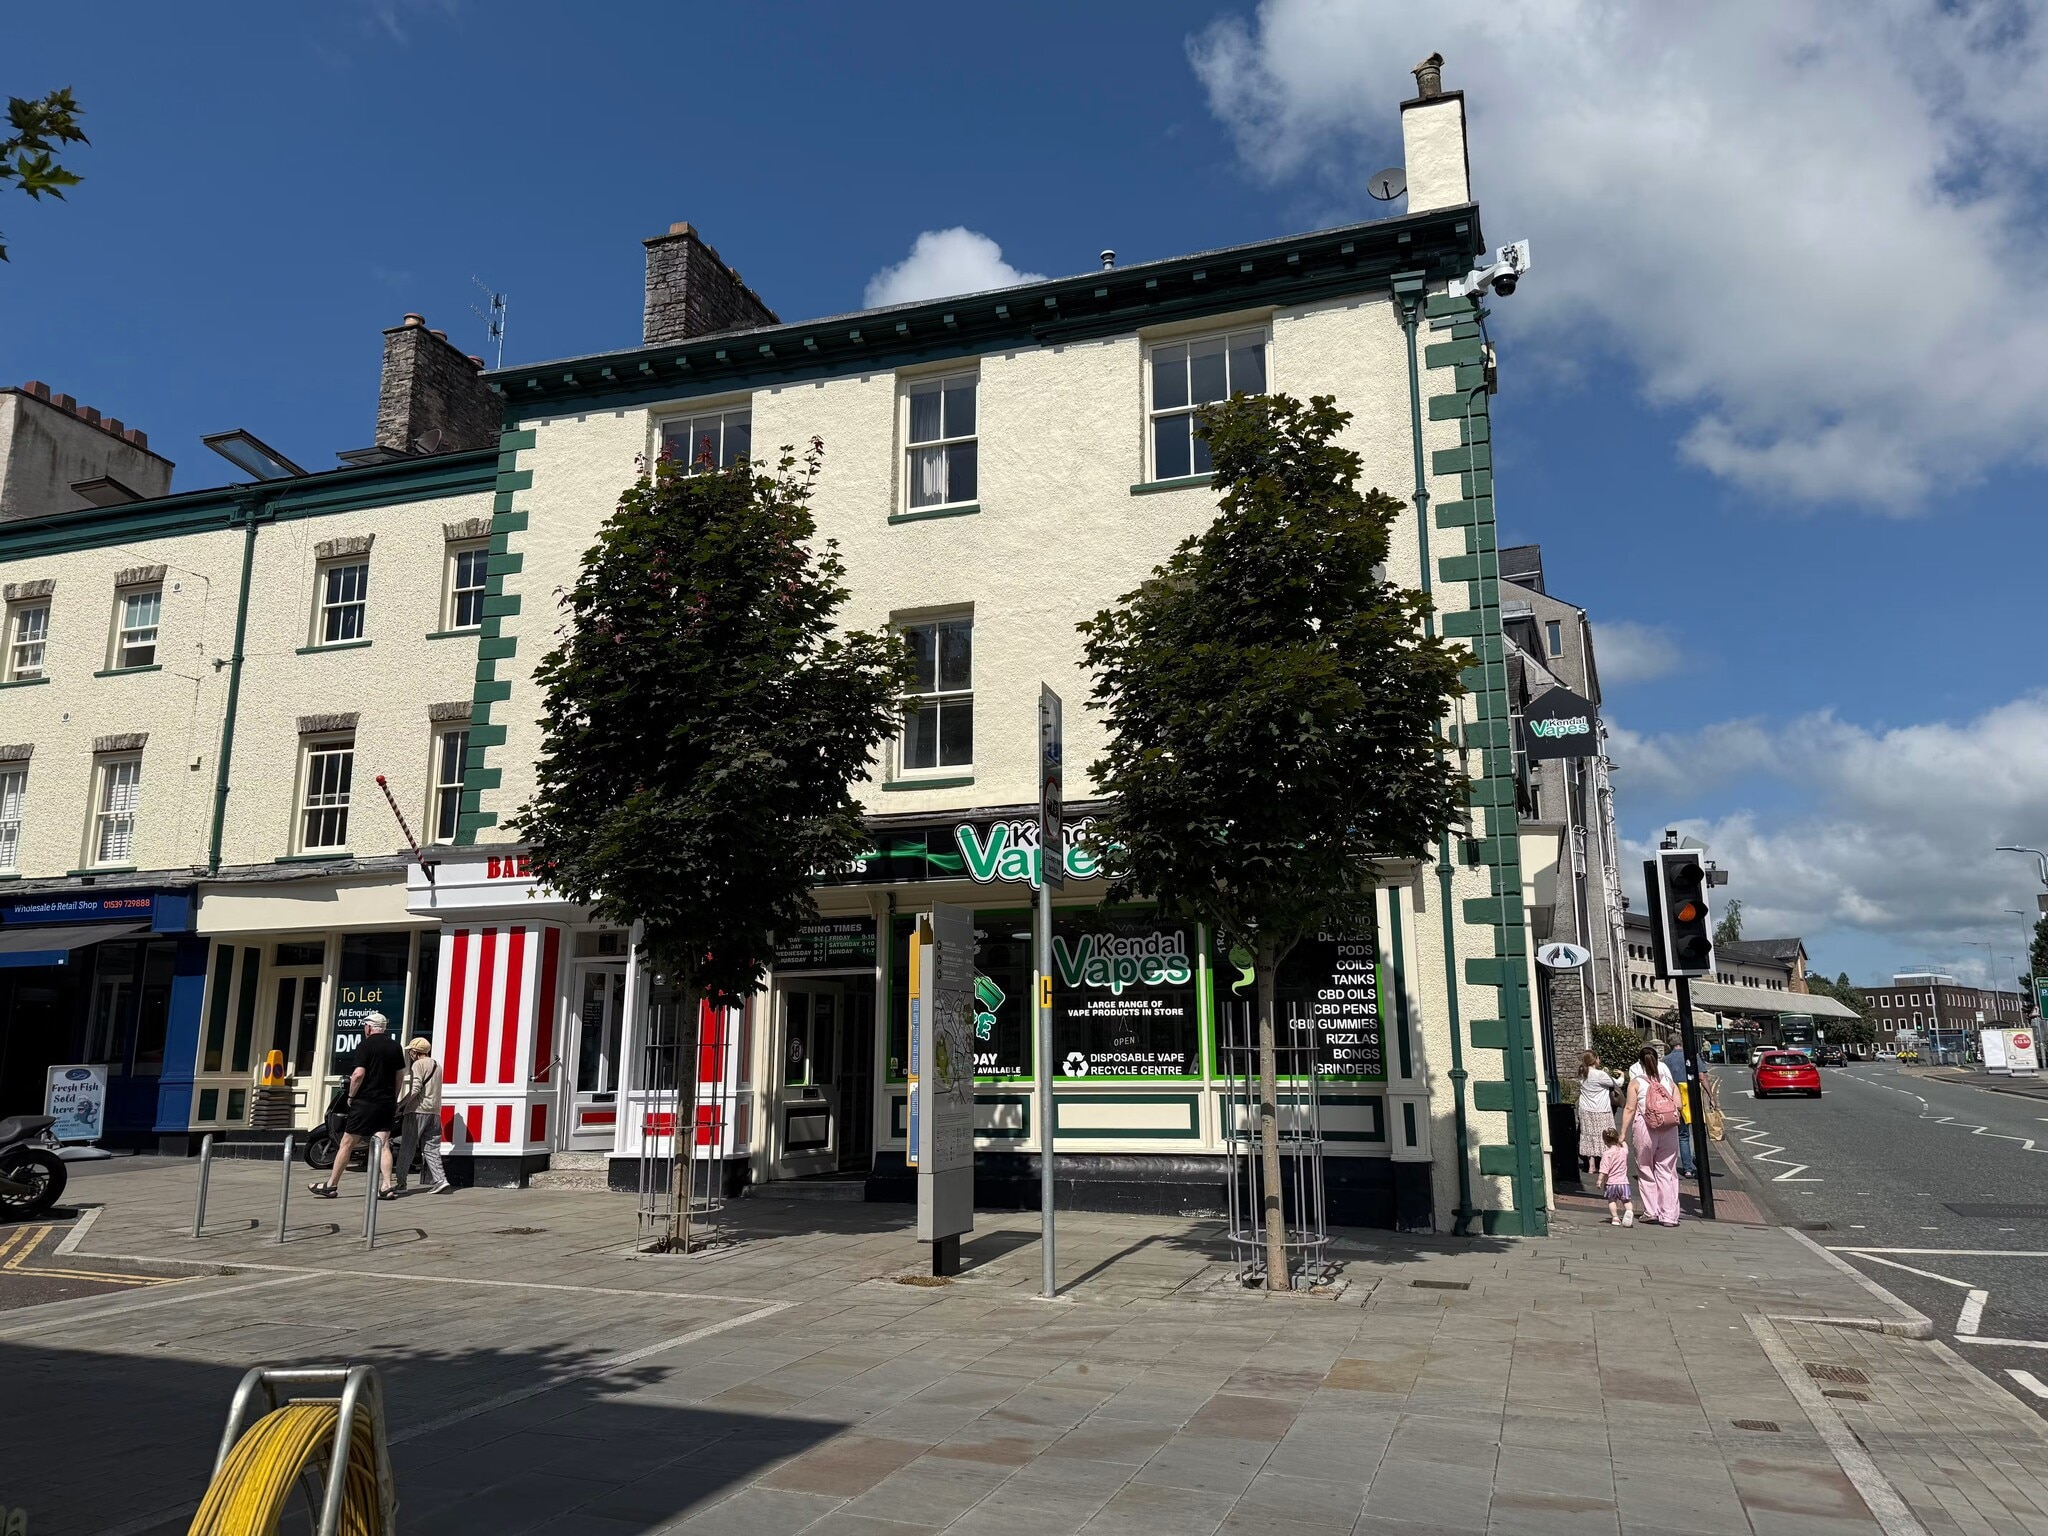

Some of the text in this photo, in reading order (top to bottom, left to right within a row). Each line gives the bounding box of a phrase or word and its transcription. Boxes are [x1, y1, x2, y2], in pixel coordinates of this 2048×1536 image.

[1549, 717, 1586, 726] Kendal
[1531, 721, 1588, 737] Vapes
[1011, 819, 1100, 848] Knd
[957, 825, 1128, 887] Vae
[14, 899, 150, 913] Wholesale & Retail Shop 01539 729888
[799, 924, 862, 934] ENING TIMES
[1096, 932, 1183, 957] Kendal
[1338, 945, 1373, 956] PODS
[1052, 936, 1190, 994] Vapes
[1336, 960, 1374, 970] COILS
[1332, 974, 1375, 985] TANKS
[341, 987, 382, 1003] To Let
[1317, 988, 1376, 1000] CBD OILS
[1087, 1000, 1163, 1009] LARGE RANGE OF
[1314, 1004, 1377, 1014] CBD PENS
[339, 1008, 348, 1017] All
[1067, 1008, 1184, 1017] VAPE PRODUCTS IN STORE
[337, 1019, 357, 1027] 01539
[1289, 1018, 1378, 1030] CBD GUMMIES
[1113, 1036, 1135, 1047] OPEN
[1326, 1034, 1379, 1044] RIZZLAS
[1090, 1053, 1185, 1063] DISPOSABLE VAPE
[1333, 1048, 1380, 1059] BONGS
[977, 1066, 1021, 1074] AVAILABLE
[1090, 1065, 1182, 1075] RECYCLE CENTRE
[1314, 1063, 1381, 1075] GRINDERS
[52, 1082, 99, 1093] Fresh Fish
[53, 1094, 76, 1103] Sold
[52, 1105, 74, 1114] here
